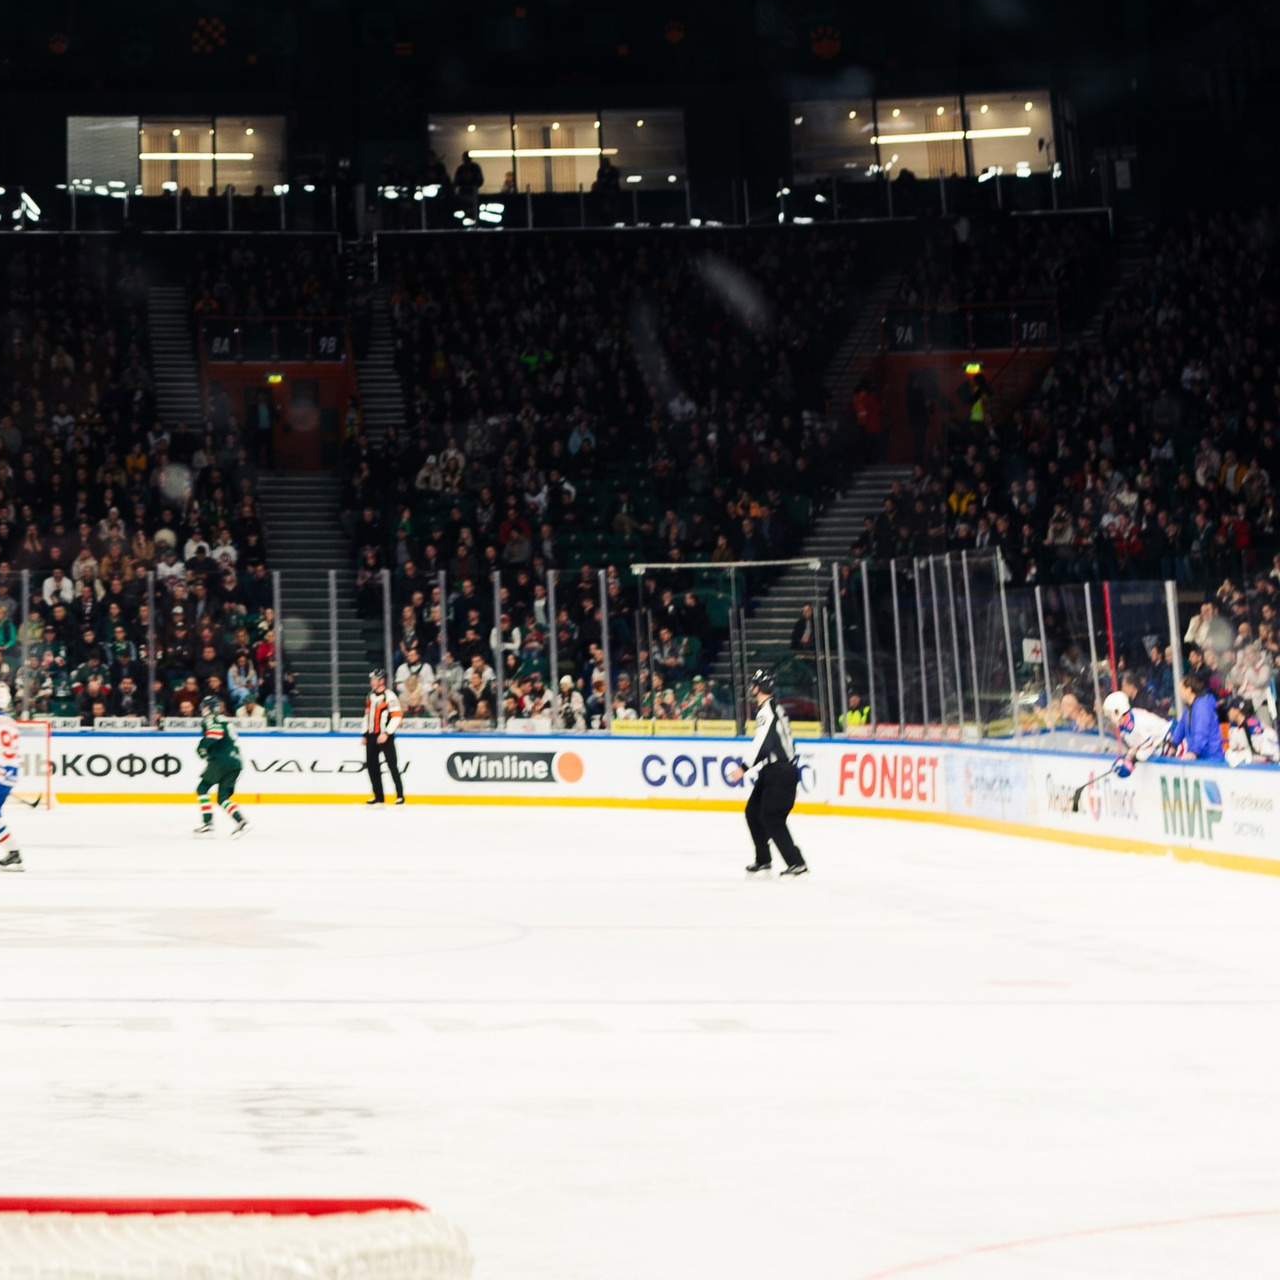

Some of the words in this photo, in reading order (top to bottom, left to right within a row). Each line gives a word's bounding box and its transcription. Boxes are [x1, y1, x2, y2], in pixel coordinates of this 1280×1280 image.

[453, 754, 550, 780] Winline
[838, 752, 939, 804] FONBET
[1160, 774, 1224, 841] МИР
